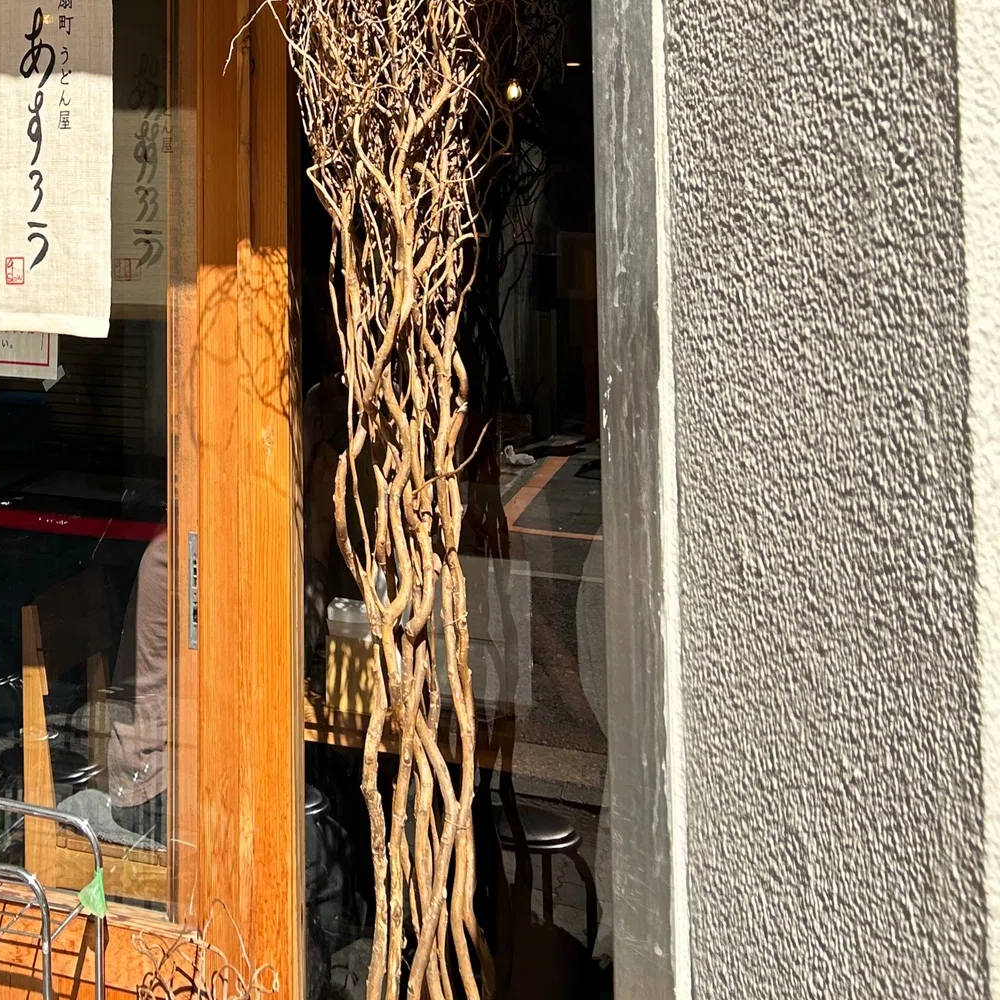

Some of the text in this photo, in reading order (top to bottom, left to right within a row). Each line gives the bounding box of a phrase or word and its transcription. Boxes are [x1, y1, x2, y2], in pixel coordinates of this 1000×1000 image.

[19, 6, 56, 271] あすろう
[57, 47, 73, 130] うどん屋
